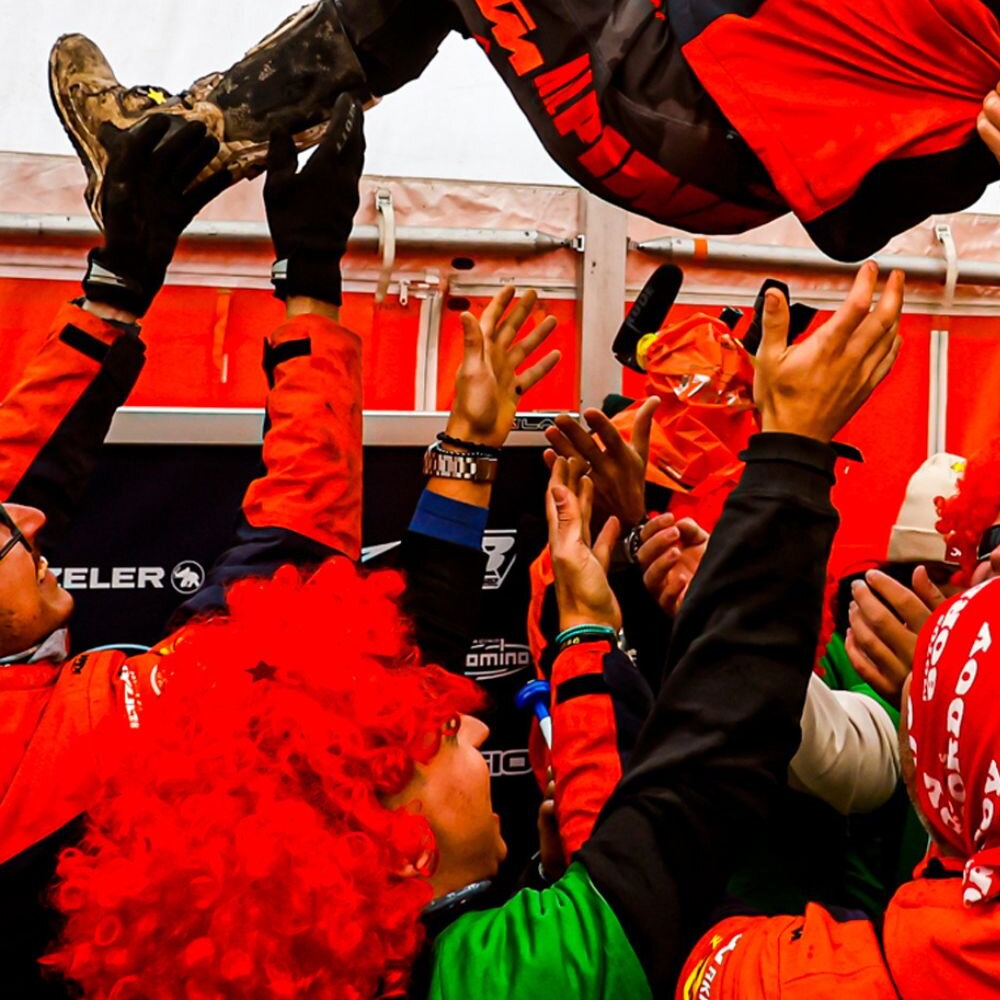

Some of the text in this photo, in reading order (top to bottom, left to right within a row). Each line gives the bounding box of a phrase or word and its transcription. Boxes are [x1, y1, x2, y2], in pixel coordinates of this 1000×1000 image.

[48, 566, 166, 589] ELER
[466, 644, 529, 667] omino
[946, 621, 992, 812] ORDOY
